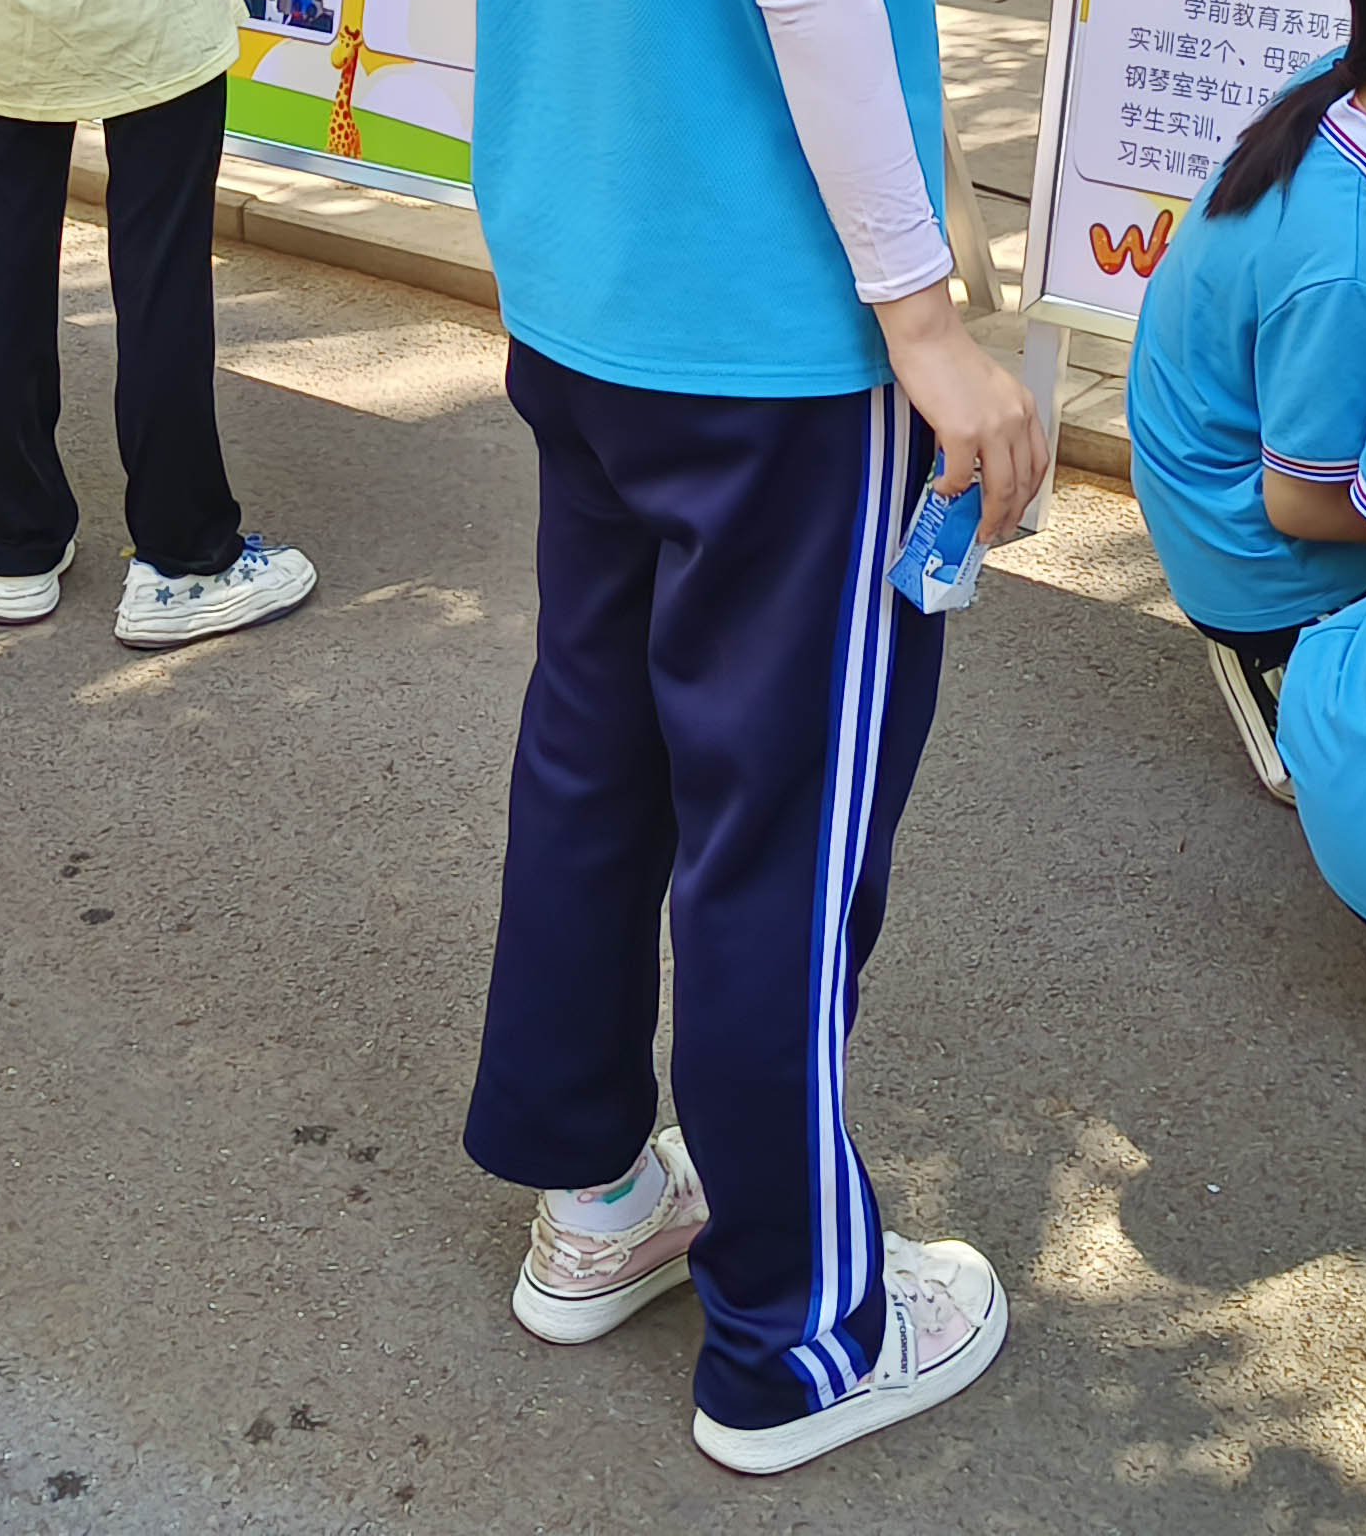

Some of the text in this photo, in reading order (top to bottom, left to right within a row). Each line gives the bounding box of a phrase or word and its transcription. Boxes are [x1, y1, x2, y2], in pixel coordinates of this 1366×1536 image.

[1128, 27, 1318, 74] 实训室2个、母婴
[1125, 64, 1275, 107] 钢琴室学位15
[1117, 140, 1219, 180] 习实训需
